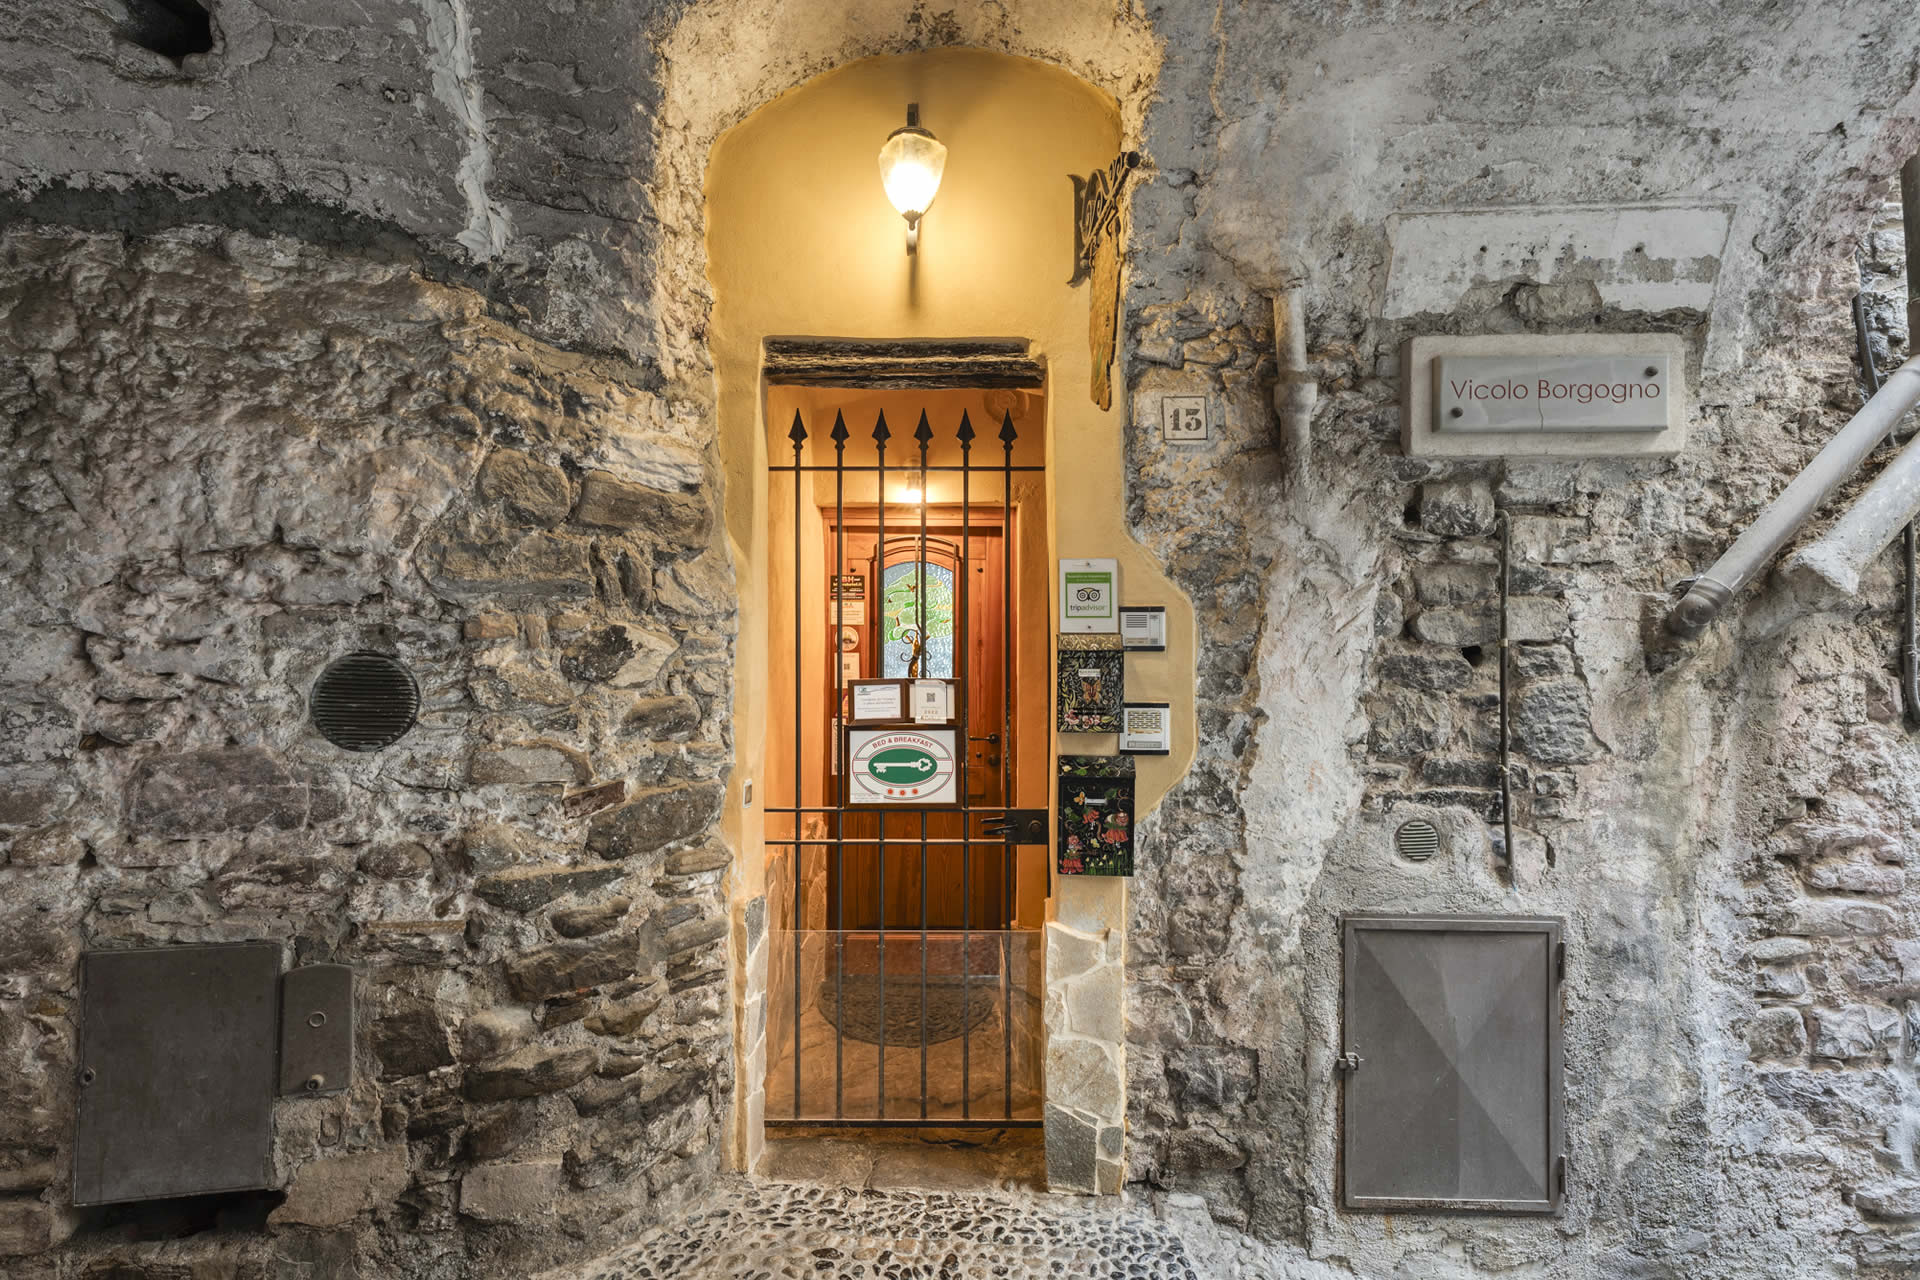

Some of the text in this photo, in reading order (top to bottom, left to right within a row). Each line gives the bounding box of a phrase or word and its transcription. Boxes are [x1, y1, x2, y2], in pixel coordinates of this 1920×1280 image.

[1451, 379, 1660, 403] Vicolo Borgogno
[1070, 604, 1105, 612] tripadvisor
[872, 739, 887, 749] BED
[894, 737, 933, 749] BREAKFAST
